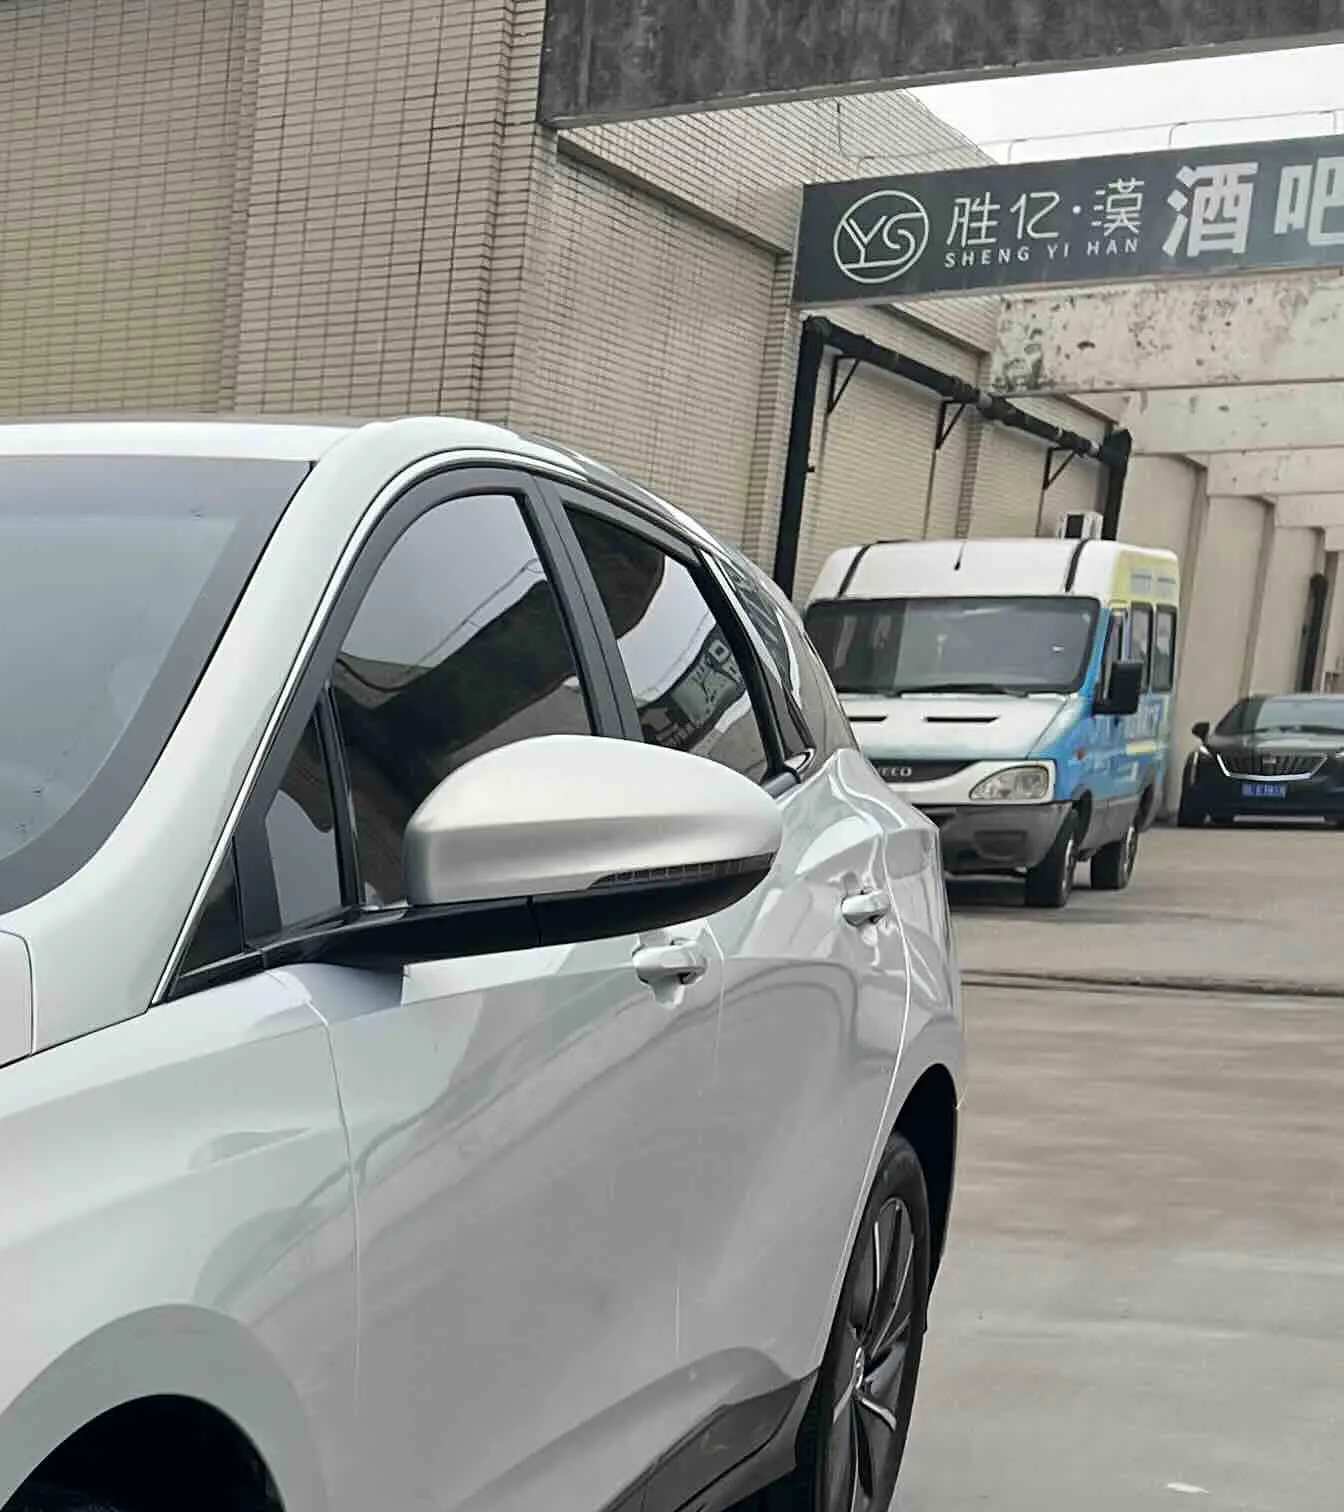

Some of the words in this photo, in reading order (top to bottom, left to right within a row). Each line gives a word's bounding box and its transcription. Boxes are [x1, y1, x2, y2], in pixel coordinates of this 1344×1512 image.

[943, 245, 1031, 269] SHENG
[1047, 242, 1070, 261] YI
[1086, 237, 1139, 257] HAN
